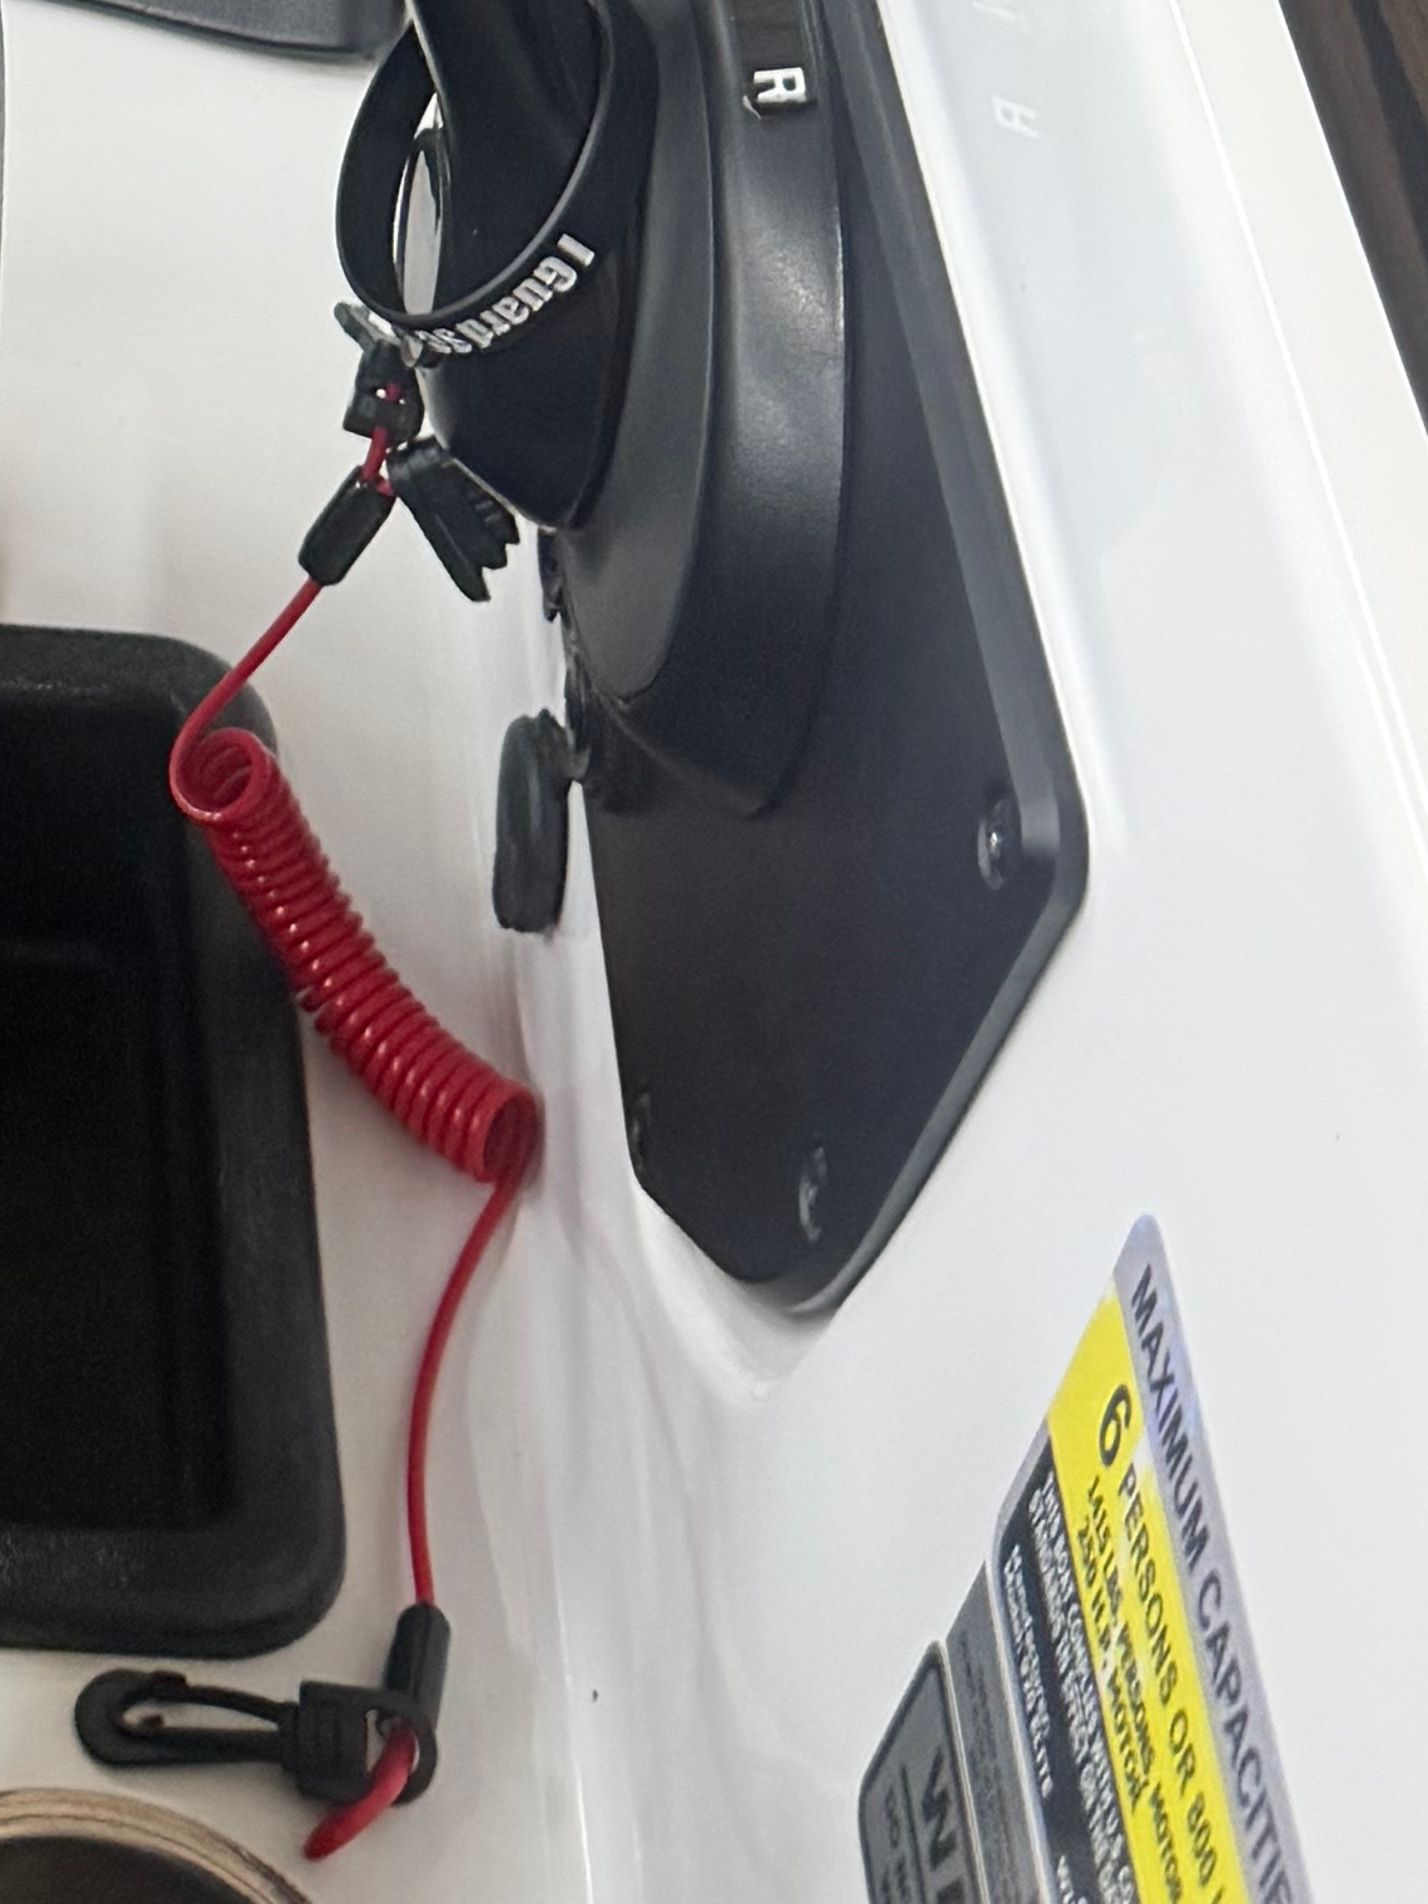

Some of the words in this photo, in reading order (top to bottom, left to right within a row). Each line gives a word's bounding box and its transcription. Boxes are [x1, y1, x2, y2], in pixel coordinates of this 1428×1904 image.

[752, 66, 808, 104] R
[455, 256, 578, 350] Guard
[1101, 1382, 1132, 1463] 6
[1131, 1264, 1209, 1573] MAXIMUM
[1119, 1463, 1178, 1706] PERSONS
[1169, 1706, 1197, 1796] OR
[1187, 1790, 1217, 1886] 800
